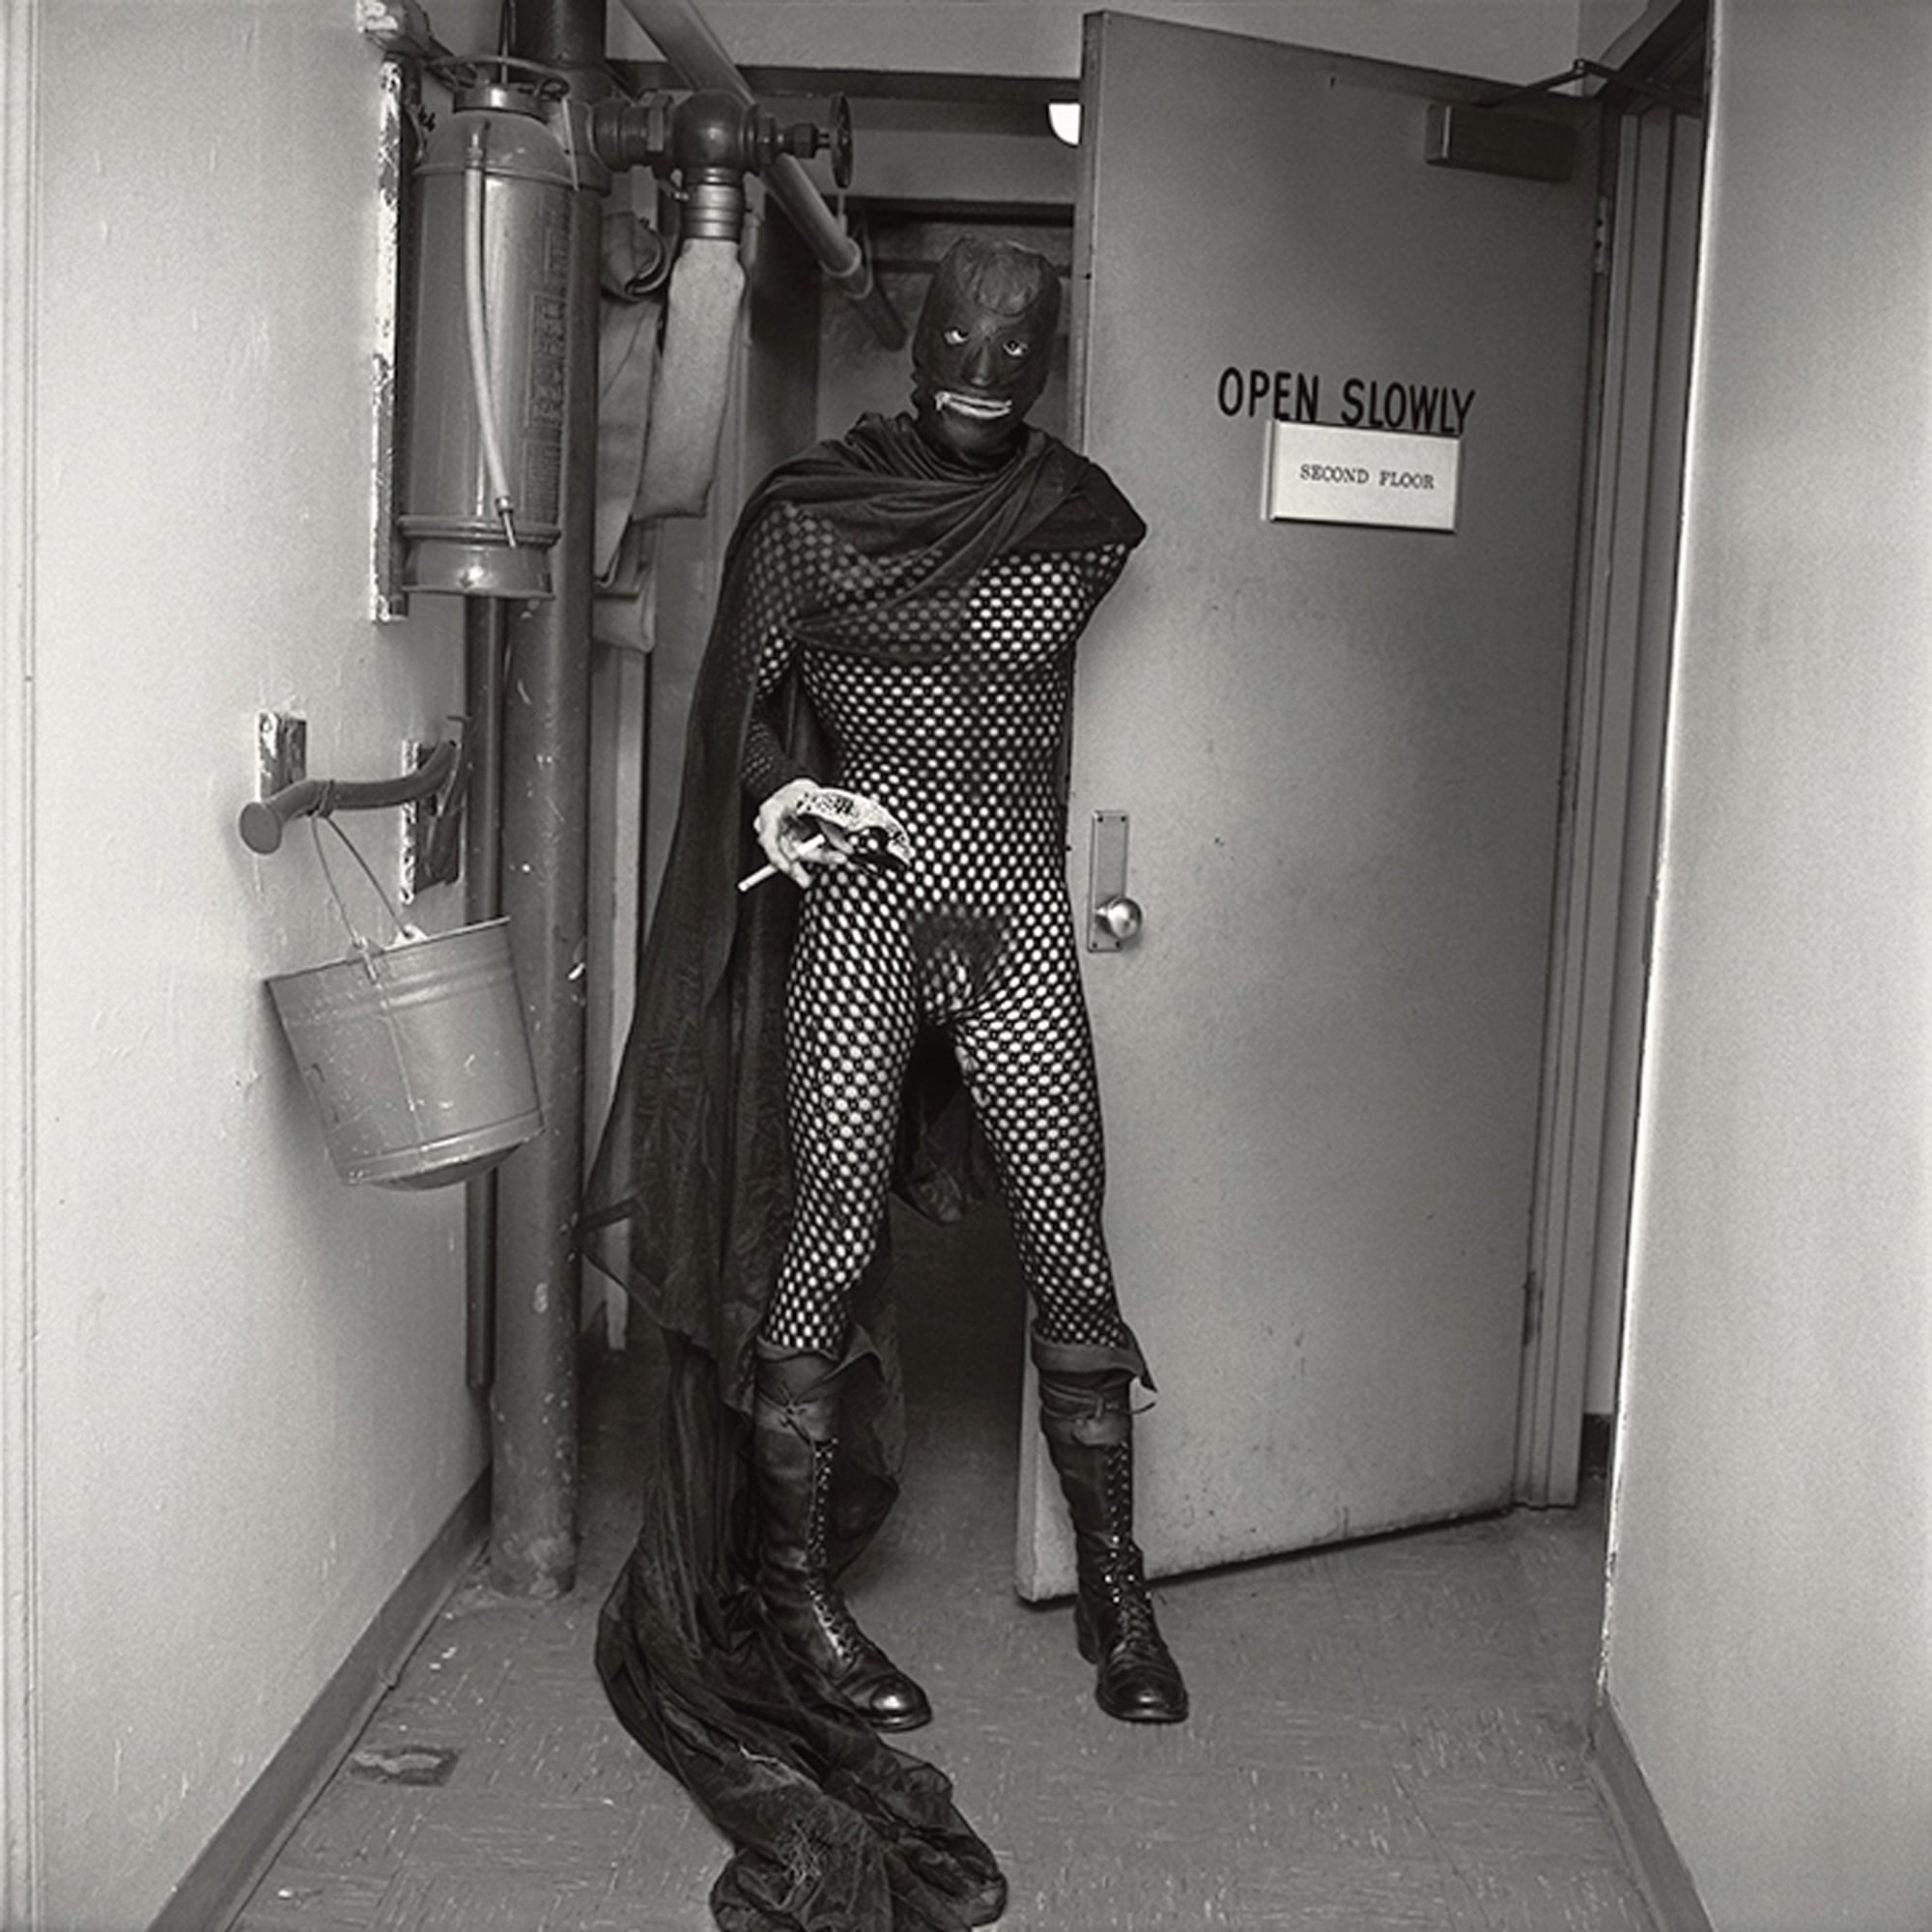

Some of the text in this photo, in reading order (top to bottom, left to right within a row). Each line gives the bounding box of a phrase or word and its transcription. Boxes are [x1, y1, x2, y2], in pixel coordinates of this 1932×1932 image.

[1218, 366, 1476, 435] OPEN SLOWLY
[1299, 464, 1435, 490] SECOND FLOOR
